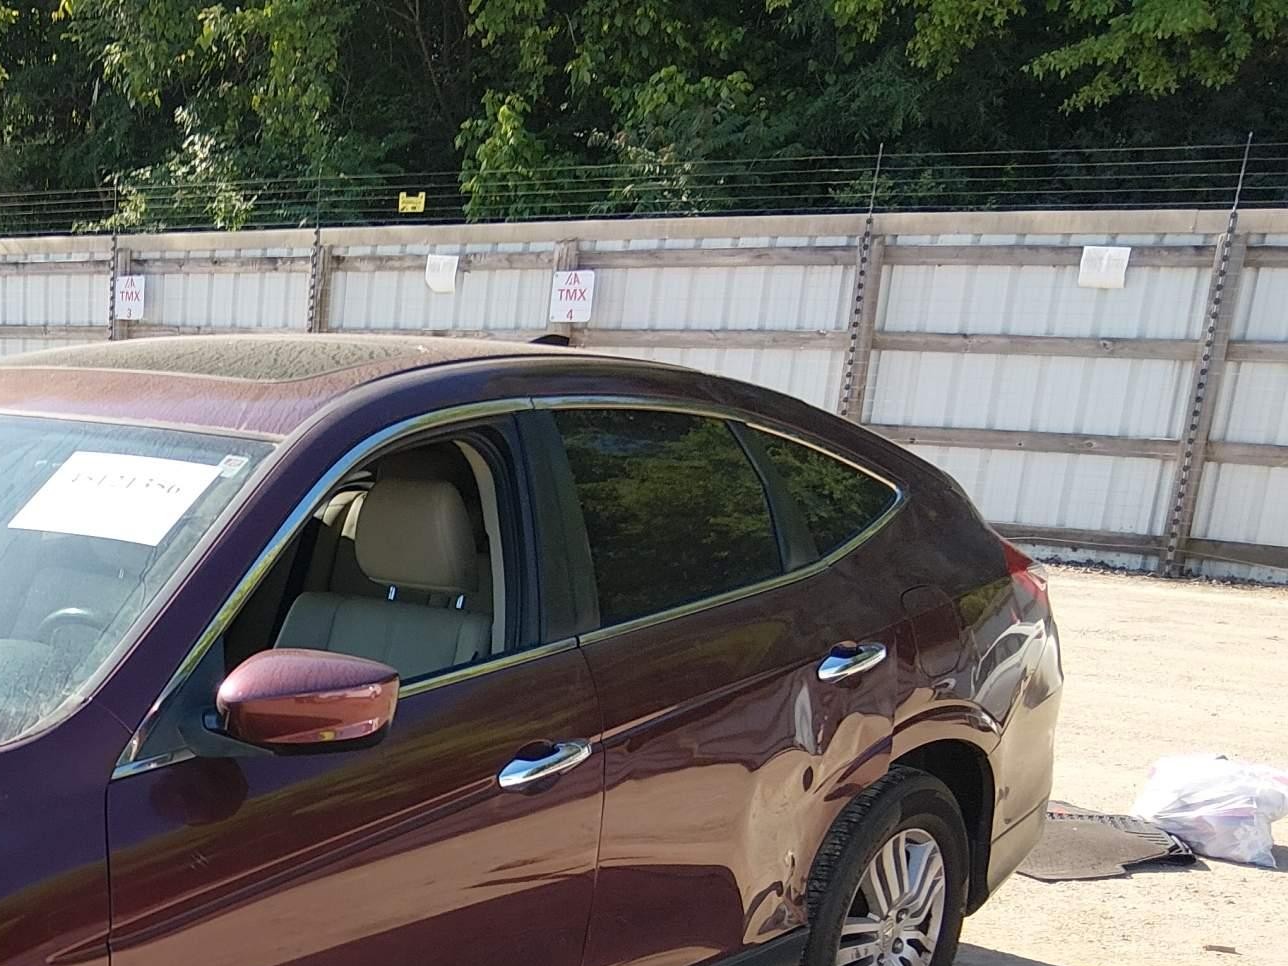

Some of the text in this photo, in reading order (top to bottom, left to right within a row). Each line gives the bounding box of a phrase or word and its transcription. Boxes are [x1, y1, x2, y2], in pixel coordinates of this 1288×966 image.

[120, 289, 141, 303] TMX
[557, 288, 588, 302] TMX
[566, 308, 574, 321] 4
